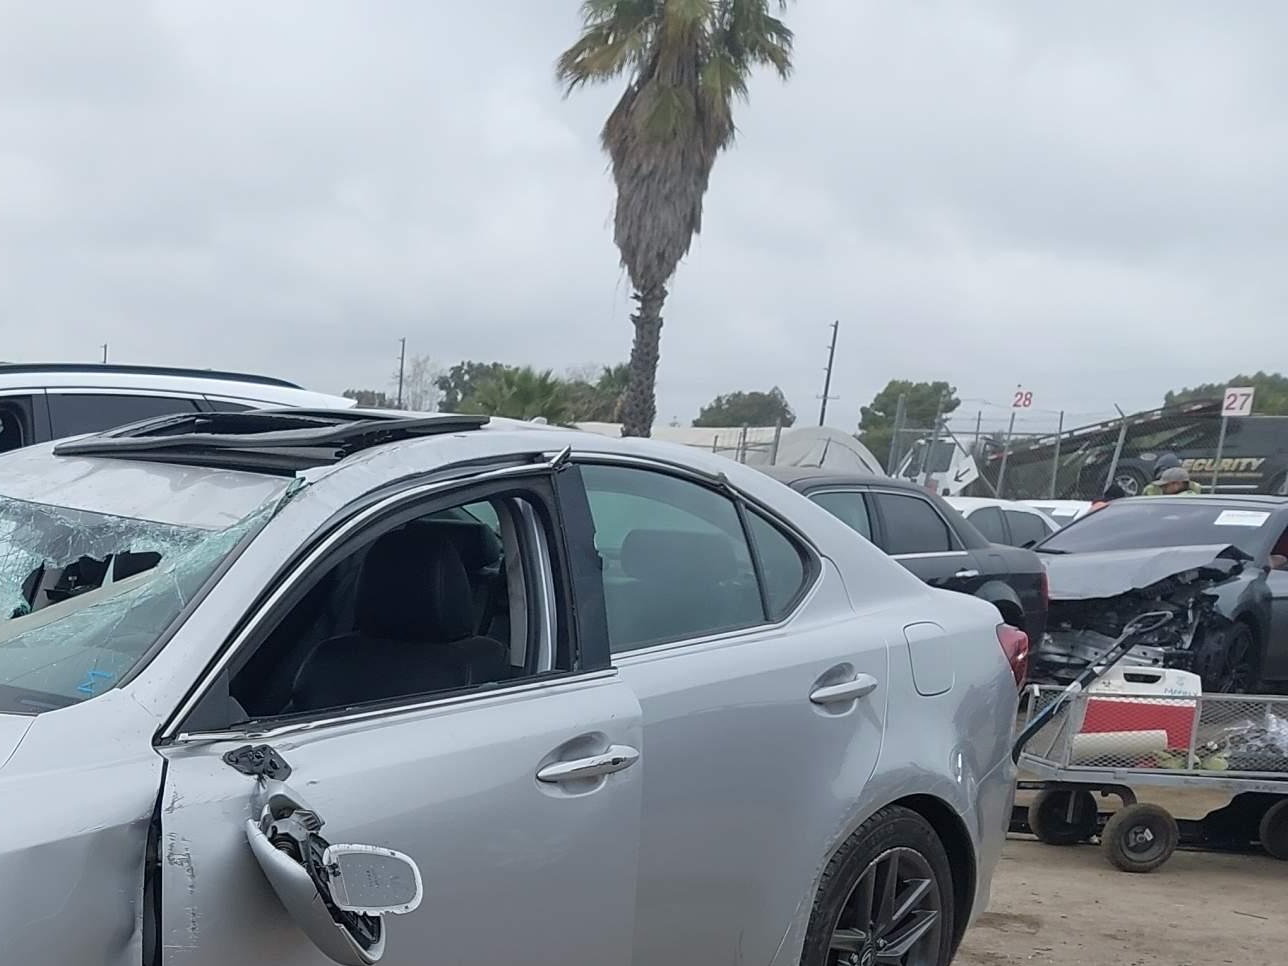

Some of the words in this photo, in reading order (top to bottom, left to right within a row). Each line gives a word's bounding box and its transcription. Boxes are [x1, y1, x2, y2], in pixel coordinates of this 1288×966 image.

[1013, 391, 1033, 407] 28
[1224, 393, 1252, 411] 27
[1178, 457, 1267, 472] ECURITY
